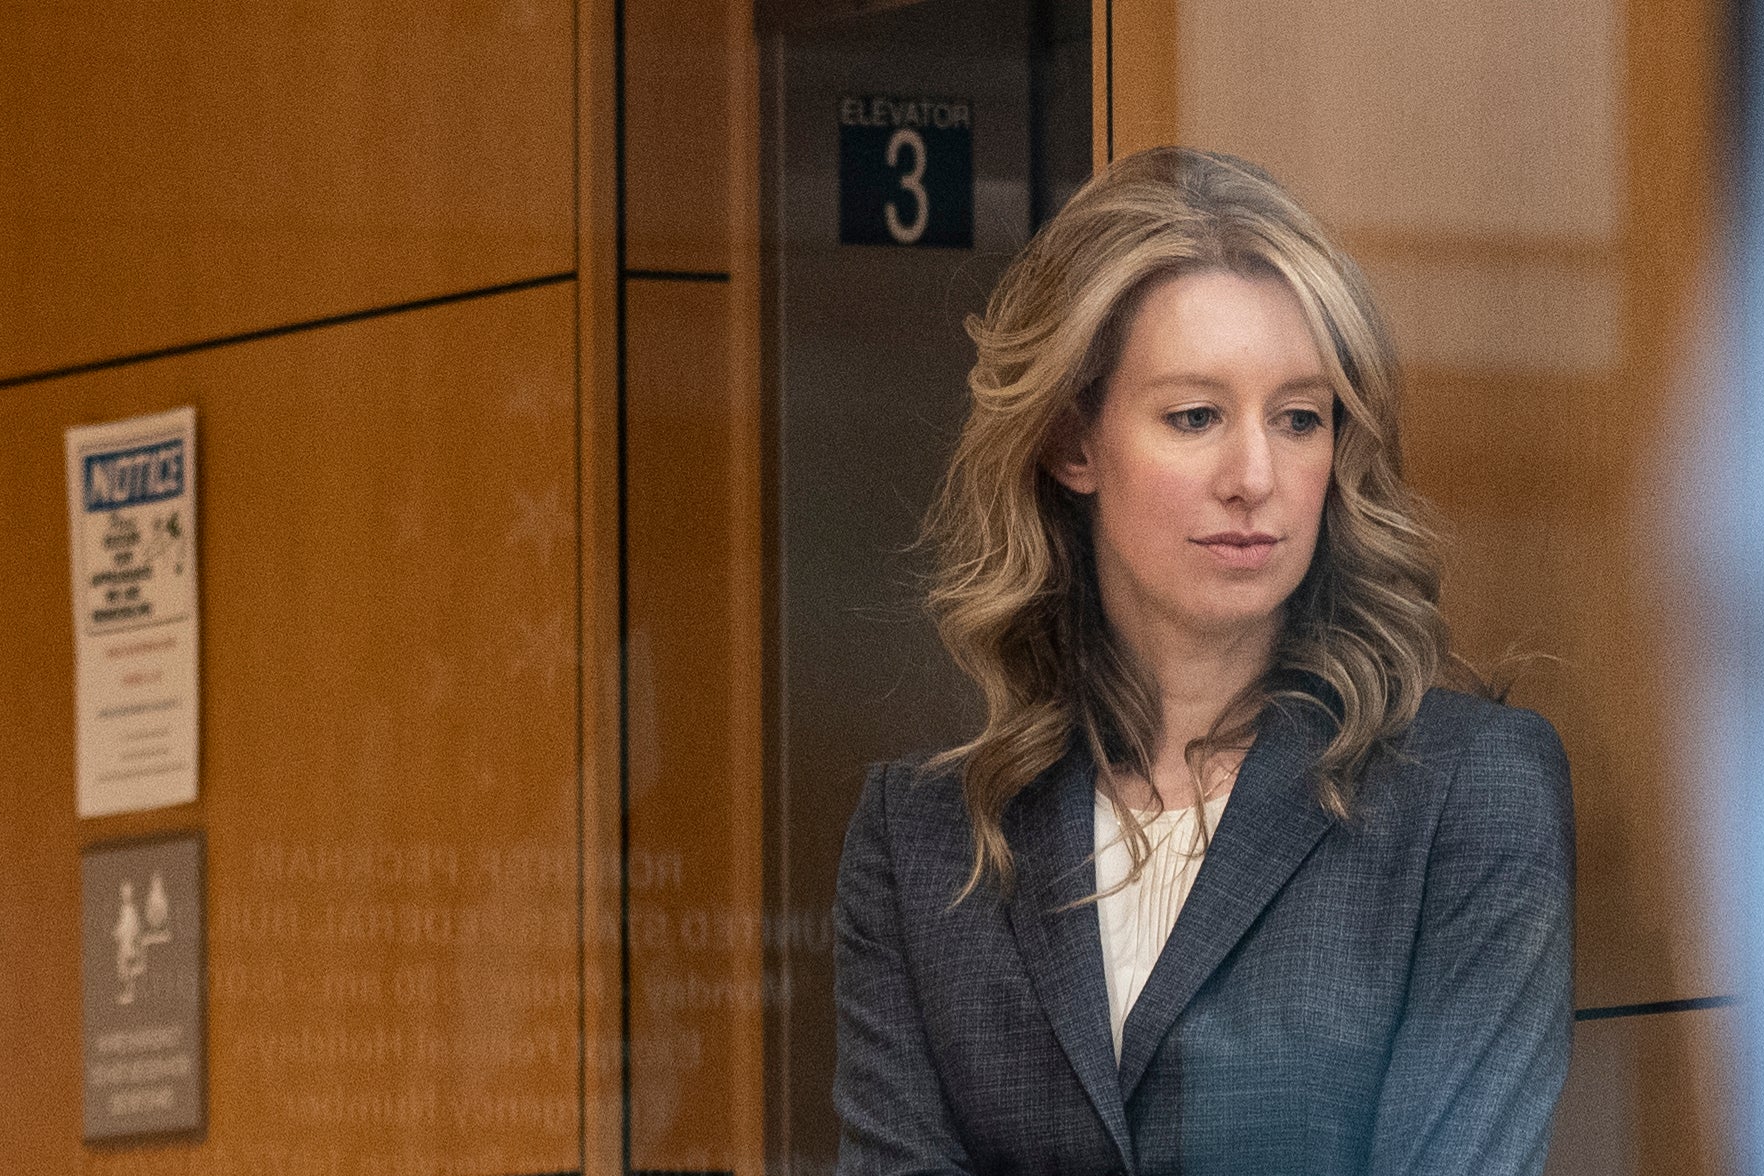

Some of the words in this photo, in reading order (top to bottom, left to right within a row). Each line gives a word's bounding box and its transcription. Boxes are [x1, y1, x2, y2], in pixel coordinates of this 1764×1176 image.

[840, 97, 971, 129] ELEVATOR
[884, 128, 930, 244] 3
[90, 446, 181, 506] NOTICE
